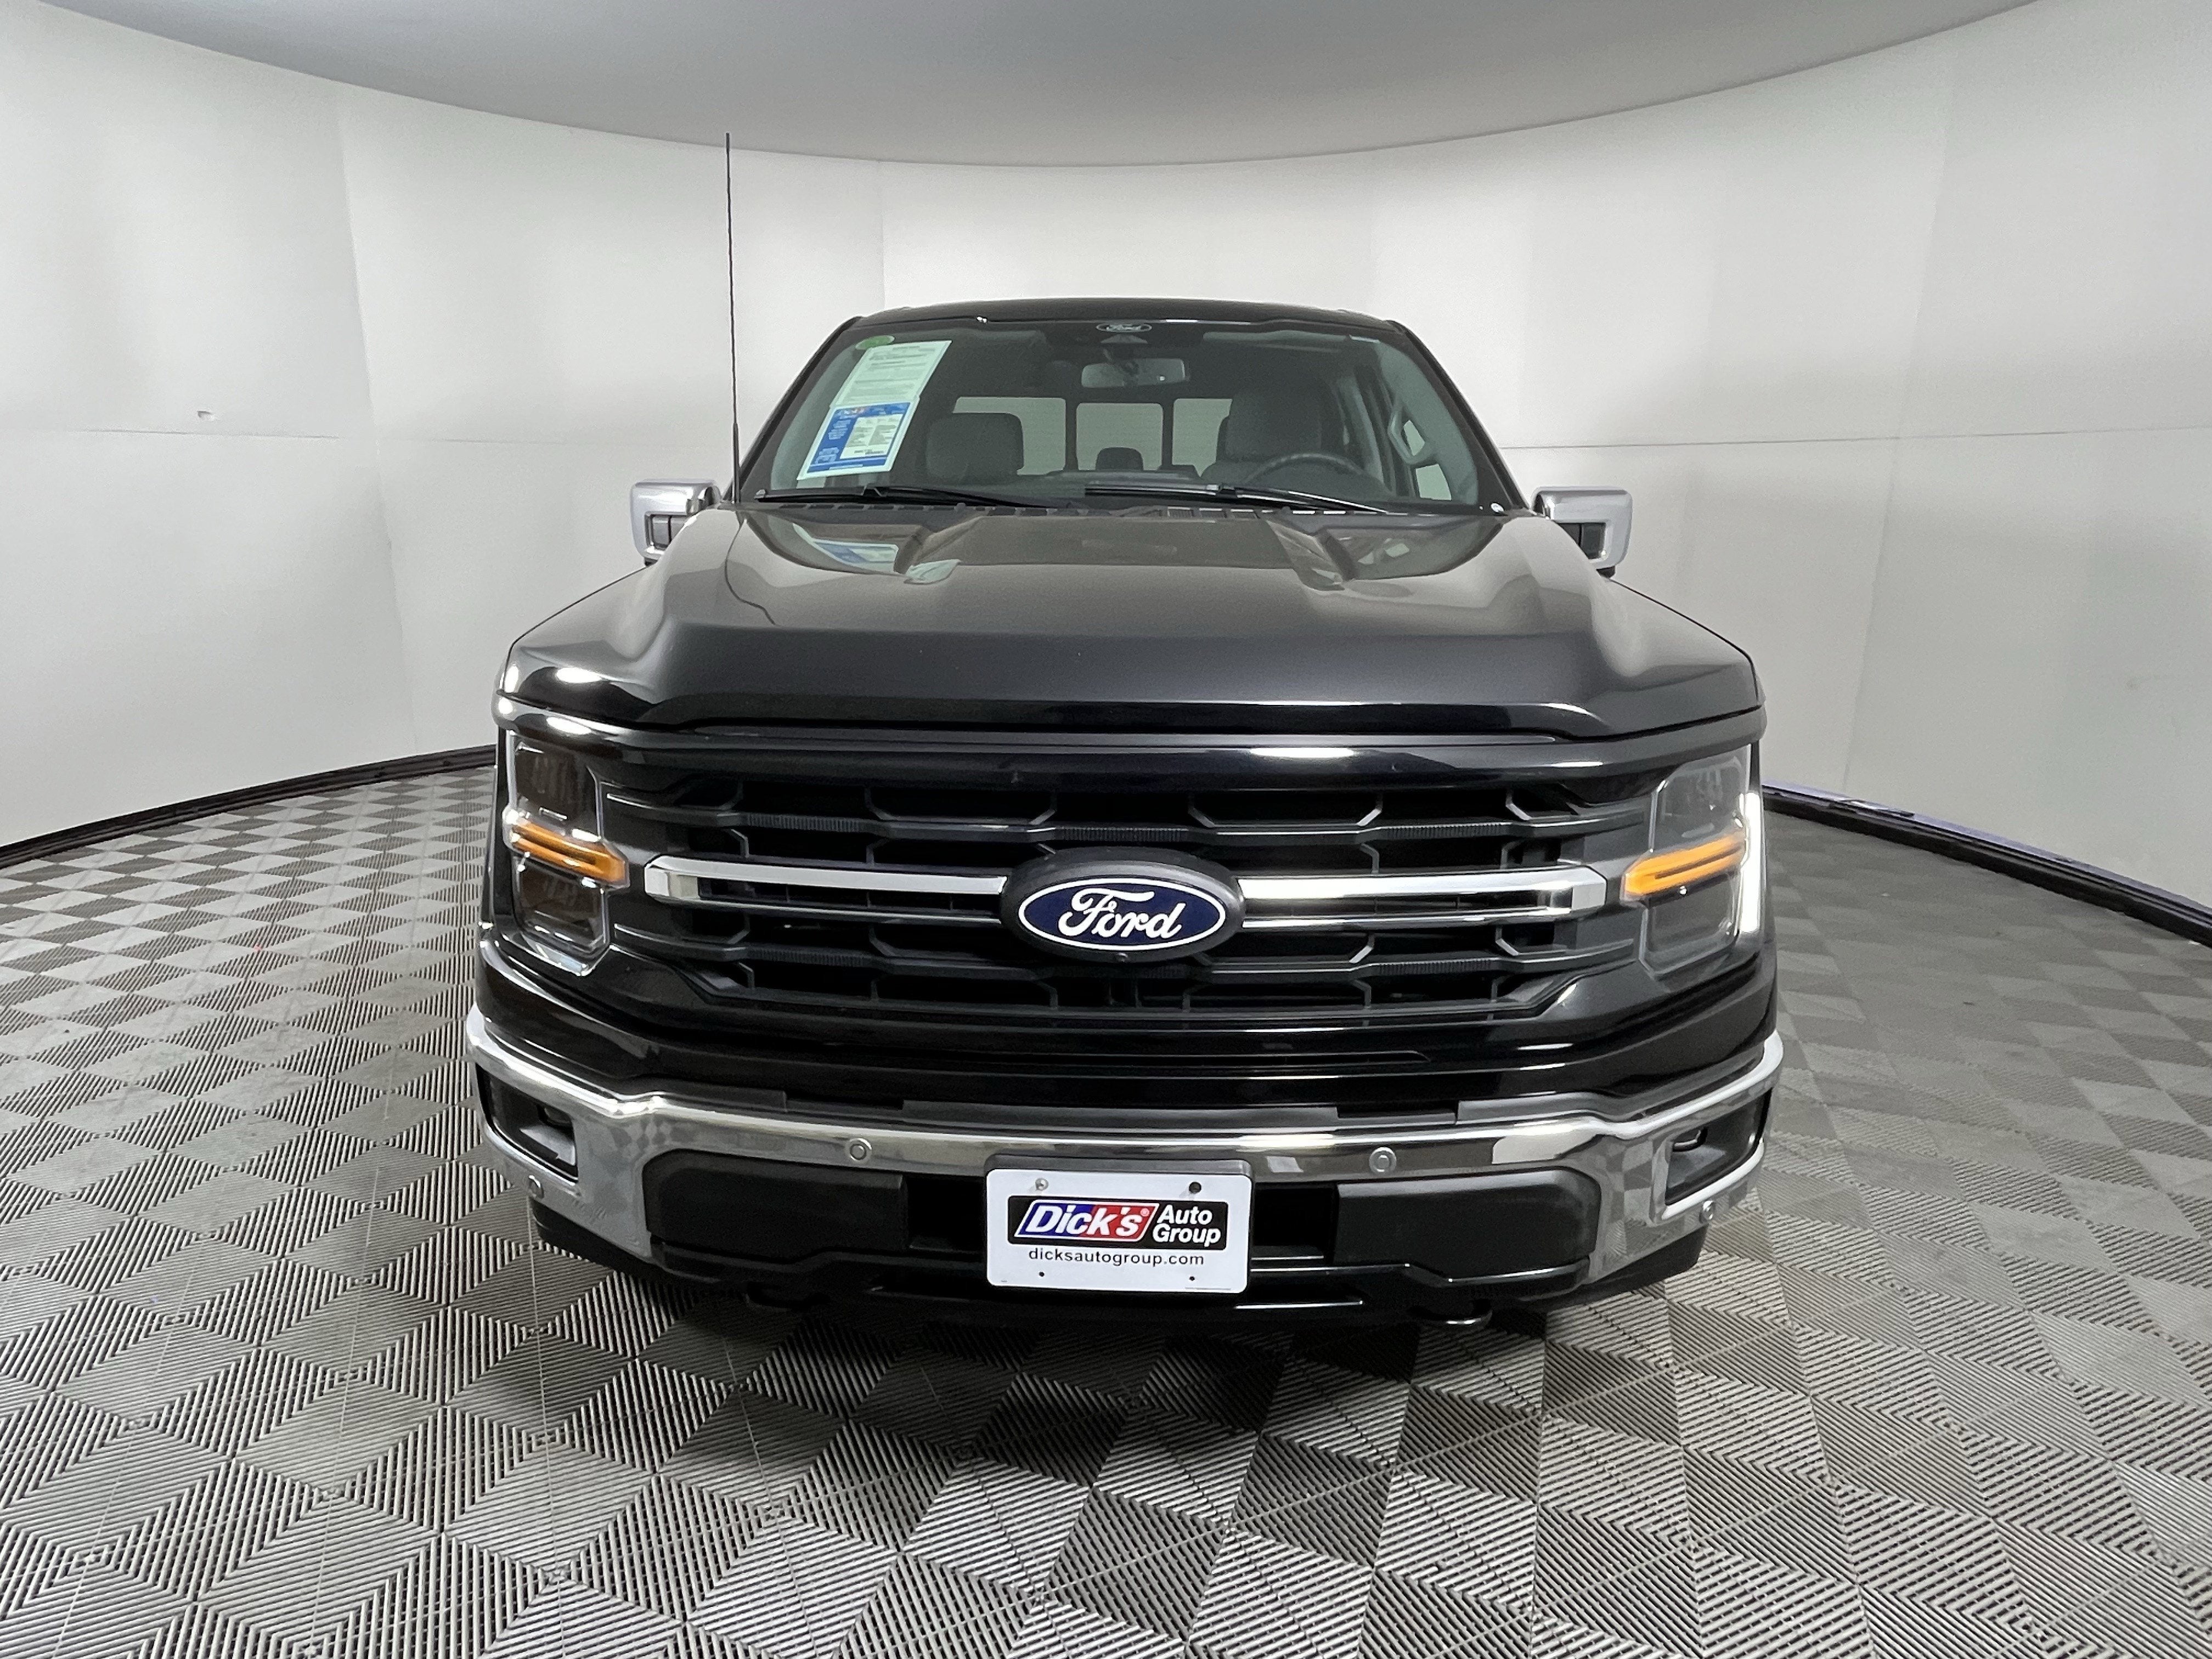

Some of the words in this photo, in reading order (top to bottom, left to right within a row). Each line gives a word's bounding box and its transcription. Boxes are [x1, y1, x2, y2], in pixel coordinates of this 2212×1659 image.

[1058, 888, 1186, 939] Ford
[1025, 1205, 1142, 1237] Dick's
[1156, 1204, 1212, 1225] Auto
[1153, 1223, 1221, 1248] Group
[1029, 1248, 1204, 1267] dicksautogroup.com
